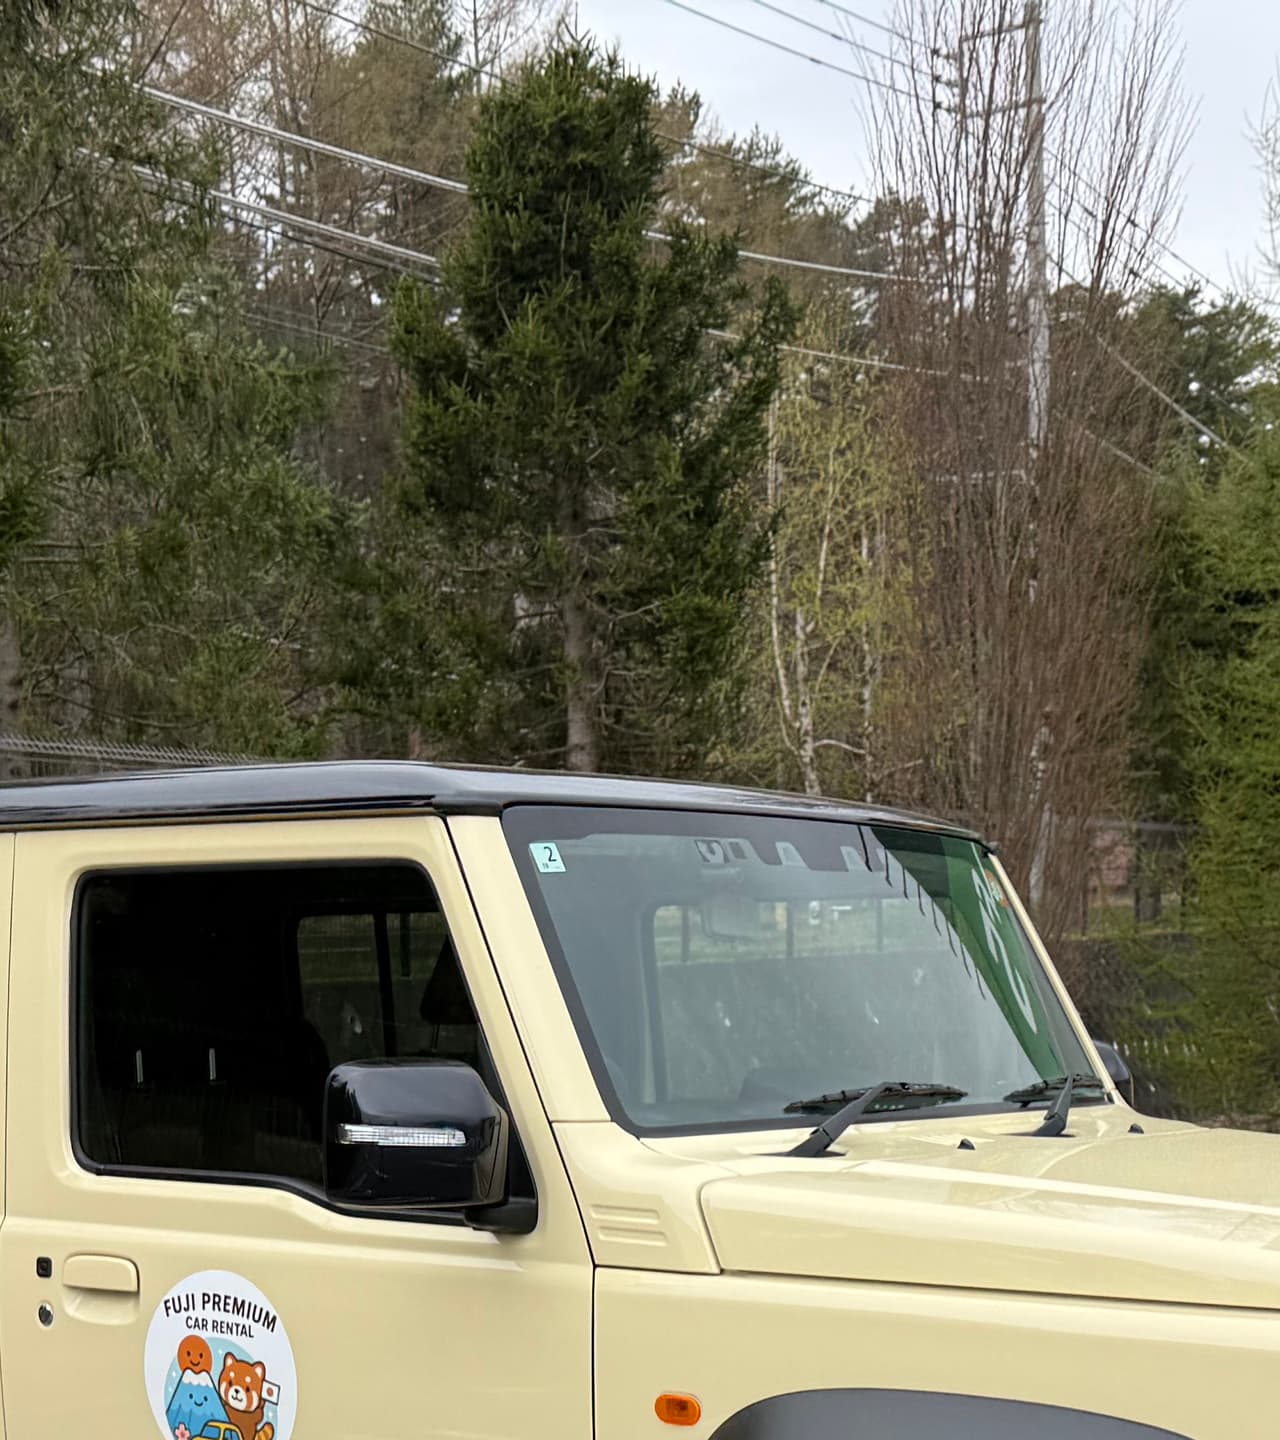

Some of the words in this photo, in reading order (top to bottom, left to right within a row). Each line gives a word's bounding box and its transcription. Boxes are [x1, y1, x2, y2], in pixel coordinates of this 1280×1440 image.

[543, 846, 557, 862] 2
[163, 1293, 196, 1318] FUJI
[201, 1292, 278, 1334] PREMIUM
[185, 1315, 208, 1332] CAR
[211, 1319, 255, 1339] RENTAL
